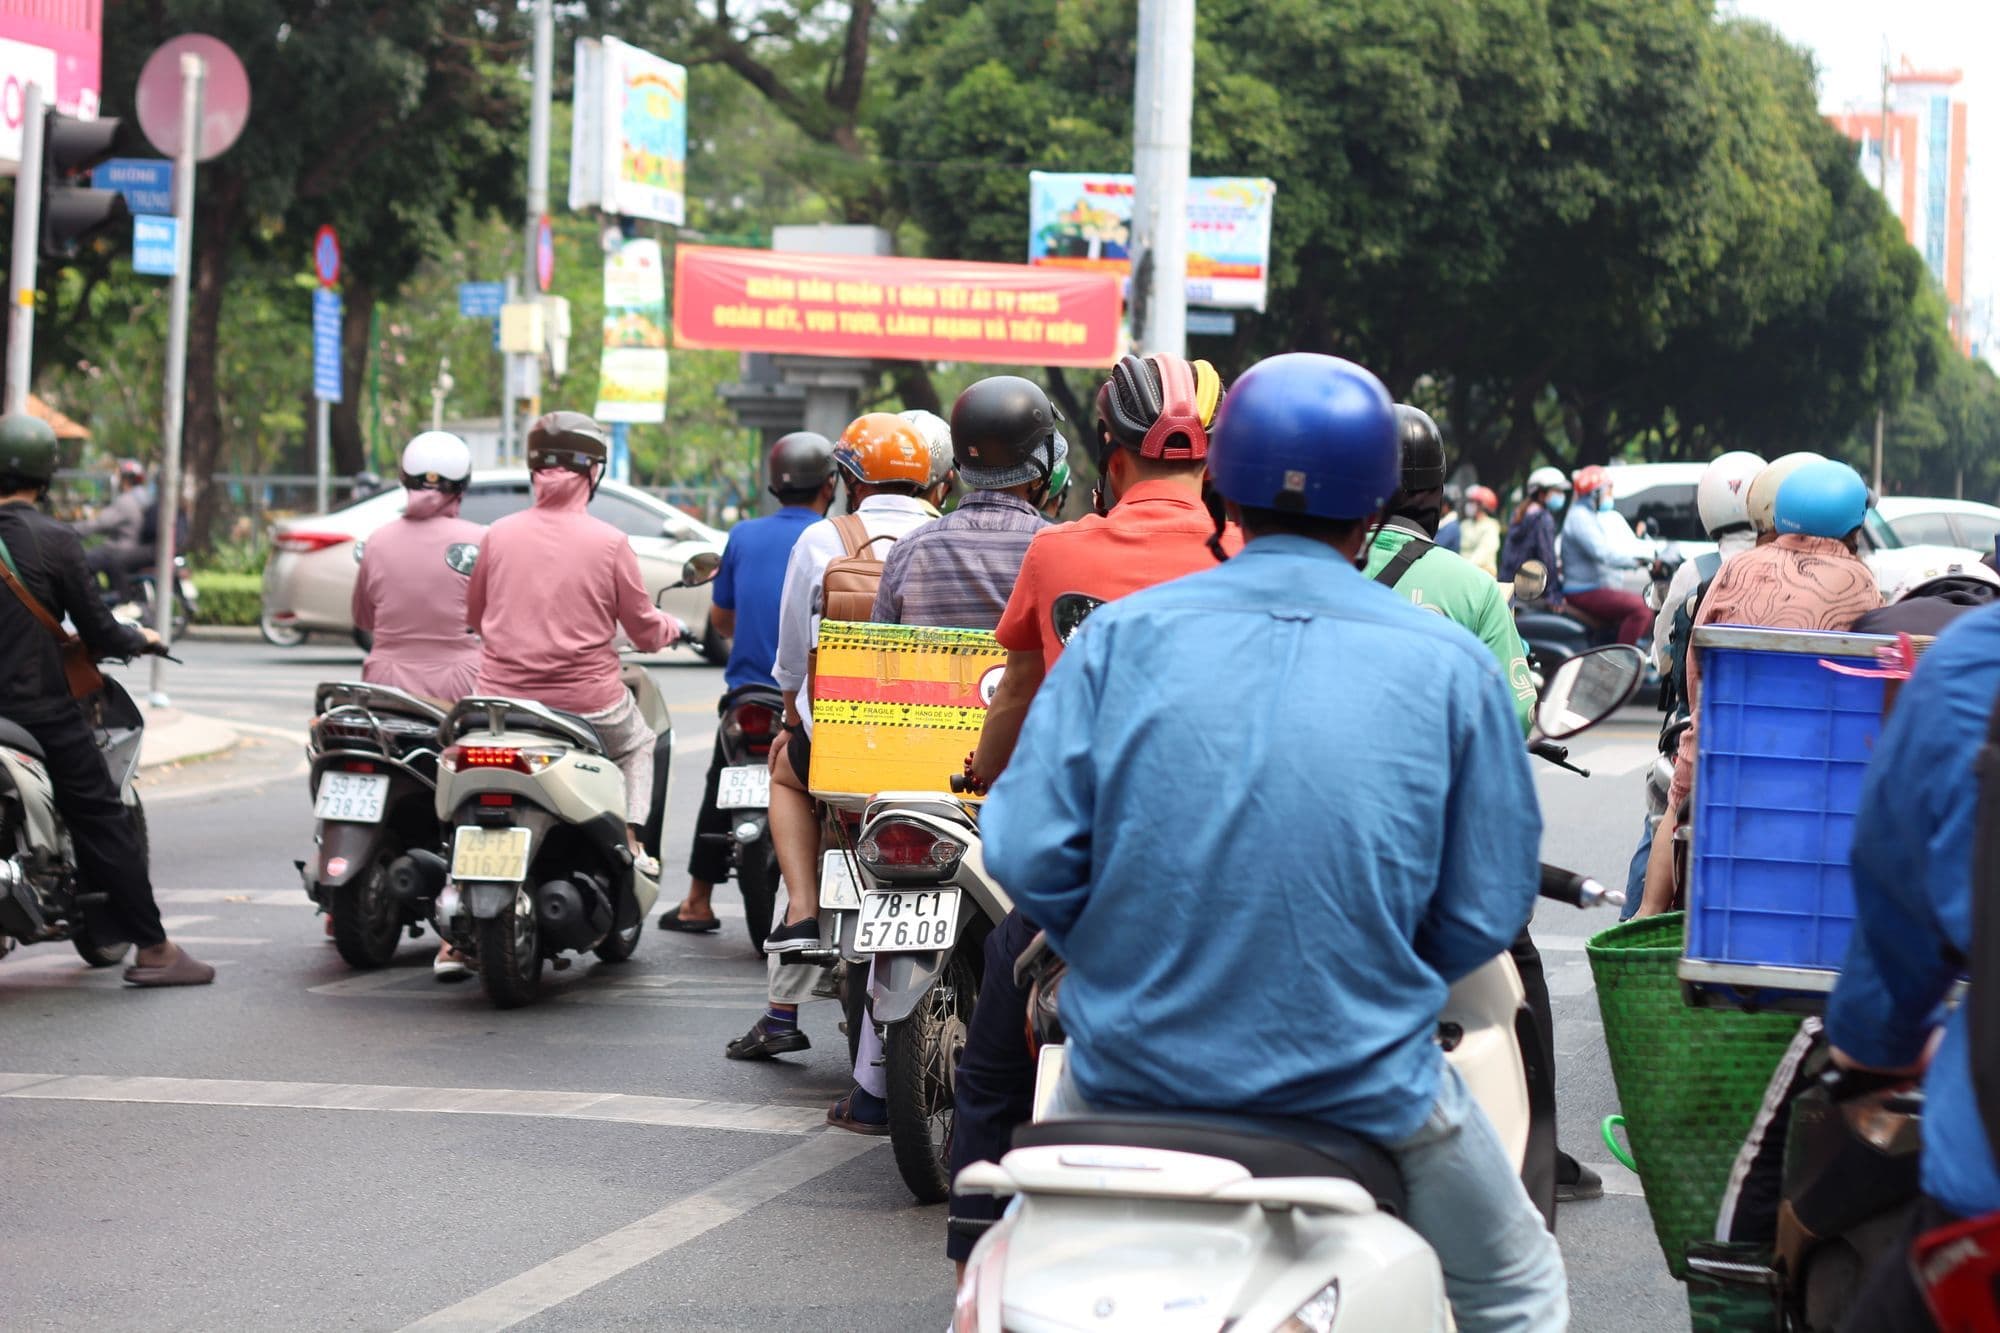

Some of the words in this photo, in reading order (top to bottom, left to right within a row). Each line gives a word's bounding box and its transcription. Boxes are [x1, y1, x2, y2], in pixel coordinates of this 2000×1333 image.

[746, 274, 795, 299] NHÂN
[798, 277, 834, 301] DÂN
[836, 281, 883, 307] QUẬN
[886, 286, 896, 304] 1
[939, 283, 968, 310] TẾT
[1018, 291, 1060, 315] 2025
[713, 302, 762, 328] ĐOÀN
[805, 310, 836, 332] VUI
[886, 310, 930, 336] LÀNH
[932, 316, 983, 341] MẠNH
[985, 315, 1008, 341] VÀ
[1010, 316, 1043, 343] TIẾT
[1046, 320, 1087, 347] KIỆM
[863, 707, 894, 715] FRAGILE
[731, 769, 768, 787] 62-U
[724, 787, 768, 805] 131.2
[874, 892, 941, 919] 78-C1
[861, 920, 947, 947] 576.08
